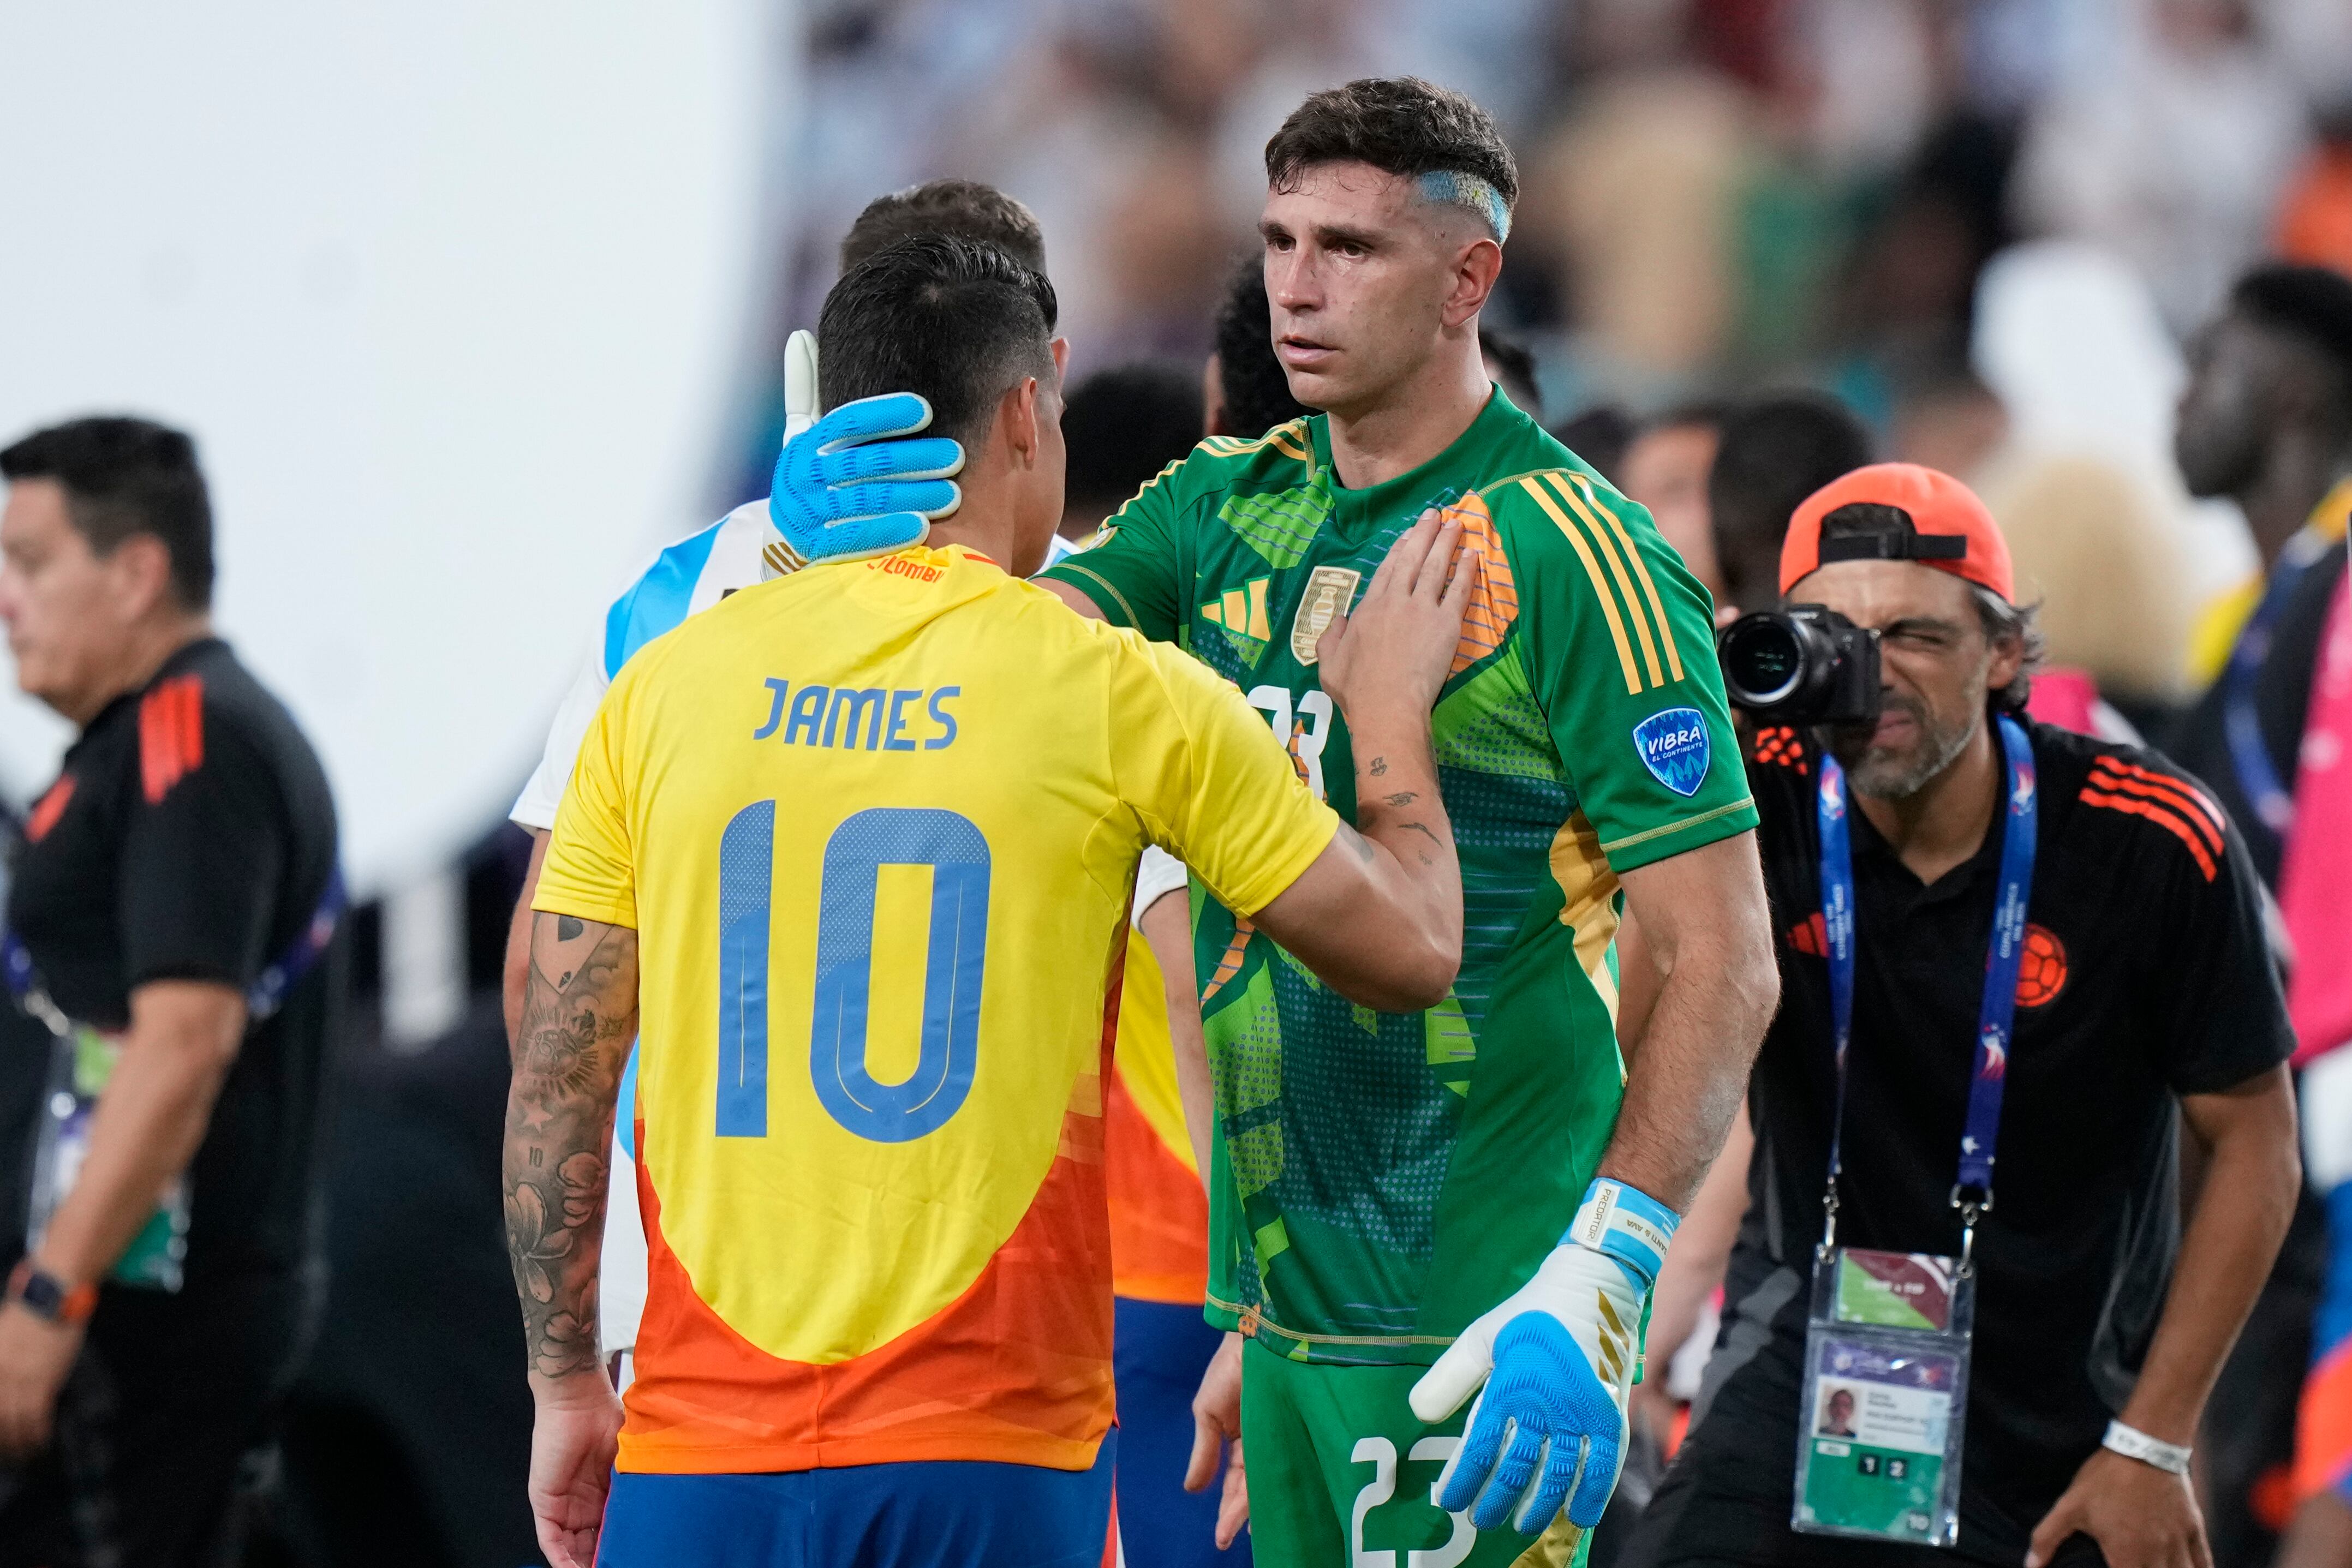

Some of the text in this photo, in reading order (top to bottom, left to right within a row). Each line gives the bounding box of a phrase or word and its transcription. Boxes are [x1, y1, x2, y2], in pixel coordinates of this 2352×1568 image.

[867, 555, 946, 584] LOMBI
[754, 677, 960, 751] JAMES
[1648, 726, 1700, 755] VIBRA
[1663, 741, 1703, 759] CONTINENTE
[715, 799, 991, 1144] 10
[529, 1146, 544, 1168] 10
[1587, 1188, 1611, 1240] PREDATOR
[1626, 1219, 1668, 1255] SANTI & AVA
